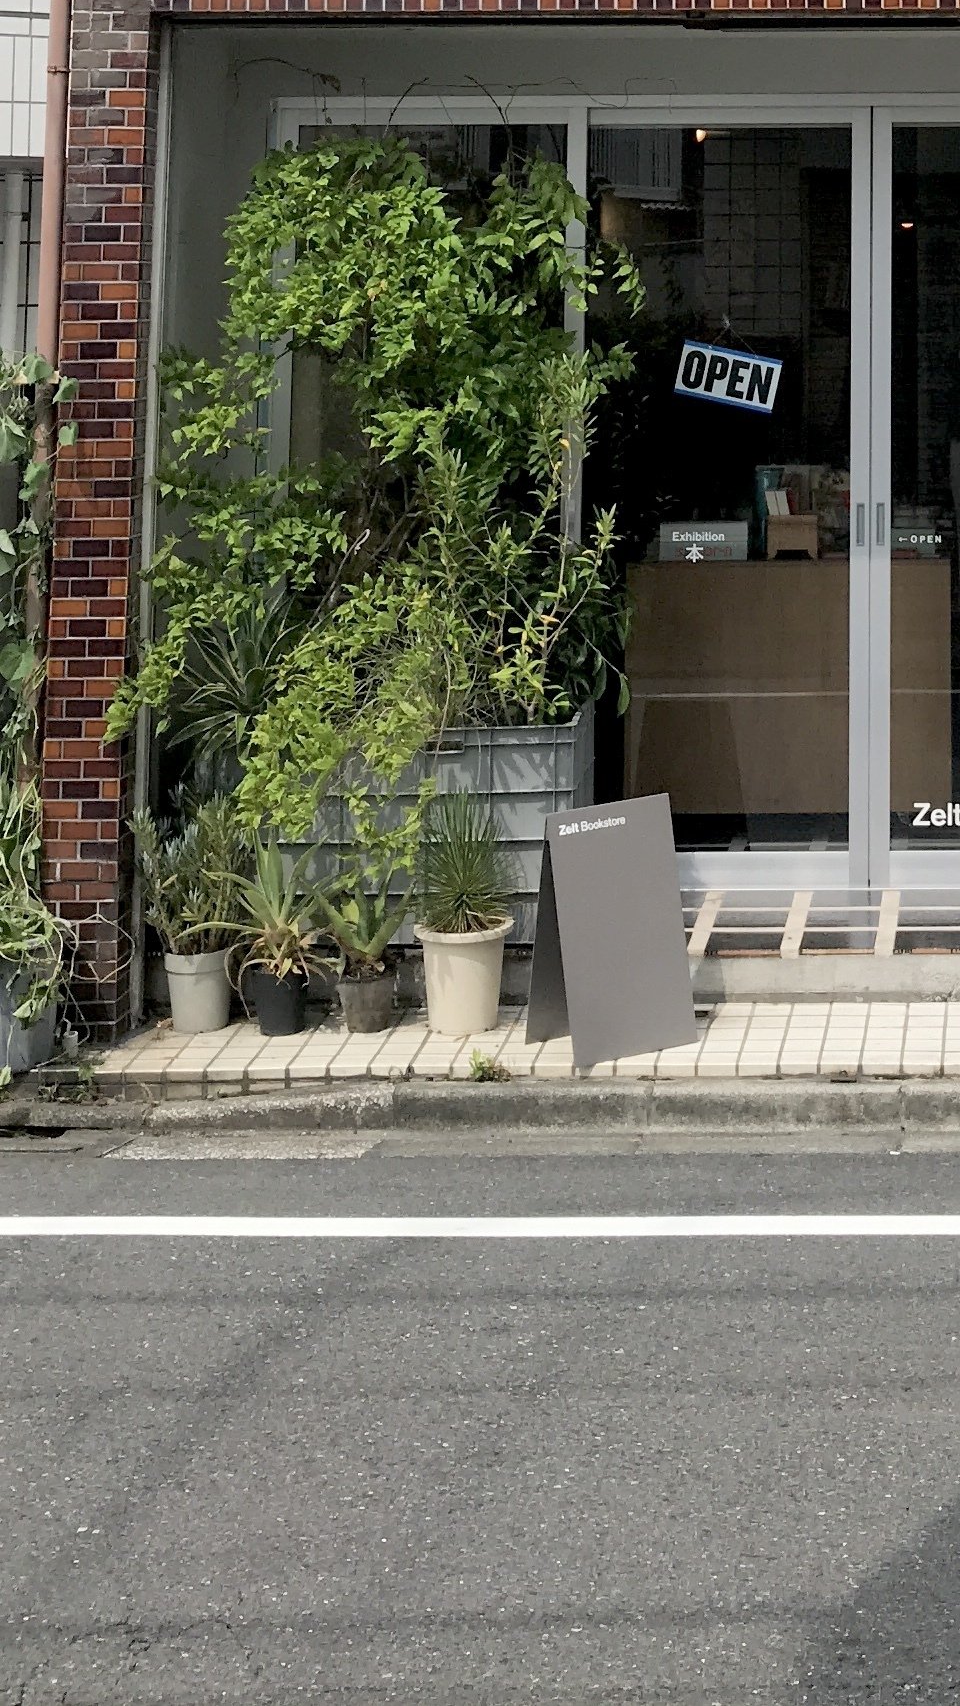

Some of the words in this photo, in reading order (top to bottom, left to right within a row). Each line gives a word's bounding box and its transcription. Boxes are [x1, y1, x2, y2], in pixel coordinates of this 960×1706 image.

[681, 350, 775, 405] OPEN
[672, 531, 725, 542] Exhibition
[910, 535, 942, 544] OPEN
[685, 543, 704, 563] 本
[558, 823, 580, 836] Zelt
[580, 816, 626, 832] Bookstore
